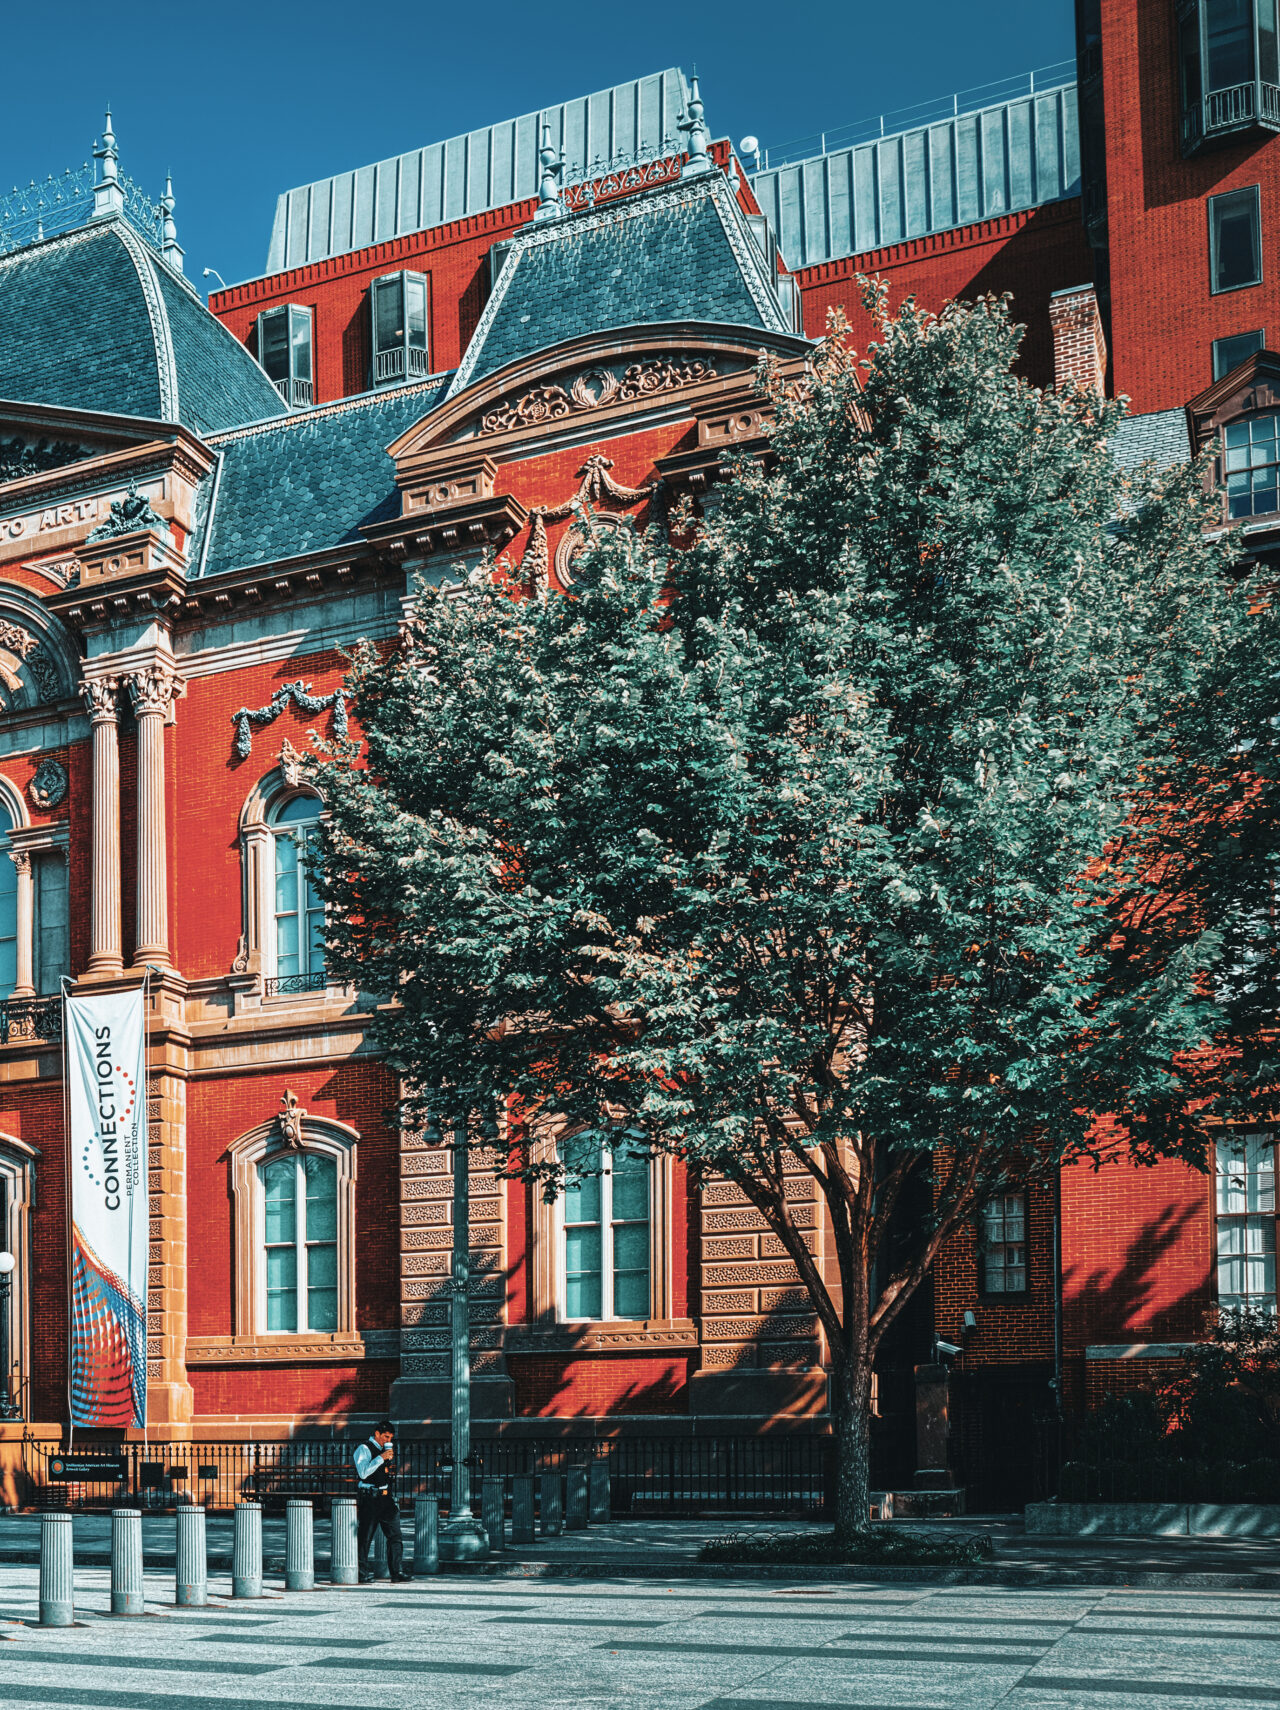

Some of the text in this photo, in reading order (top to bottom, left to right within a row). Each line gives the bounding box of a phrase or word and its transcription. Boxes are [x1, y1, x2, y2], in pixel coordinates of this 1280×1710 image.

[39, 498, 97, 531] ART.
[95, 1025, 121, 1211] CONNECTIONS
[123, 1134, 133, 1197] PERMANENT
[131, 1122, 140, 1186] COLLECTION
